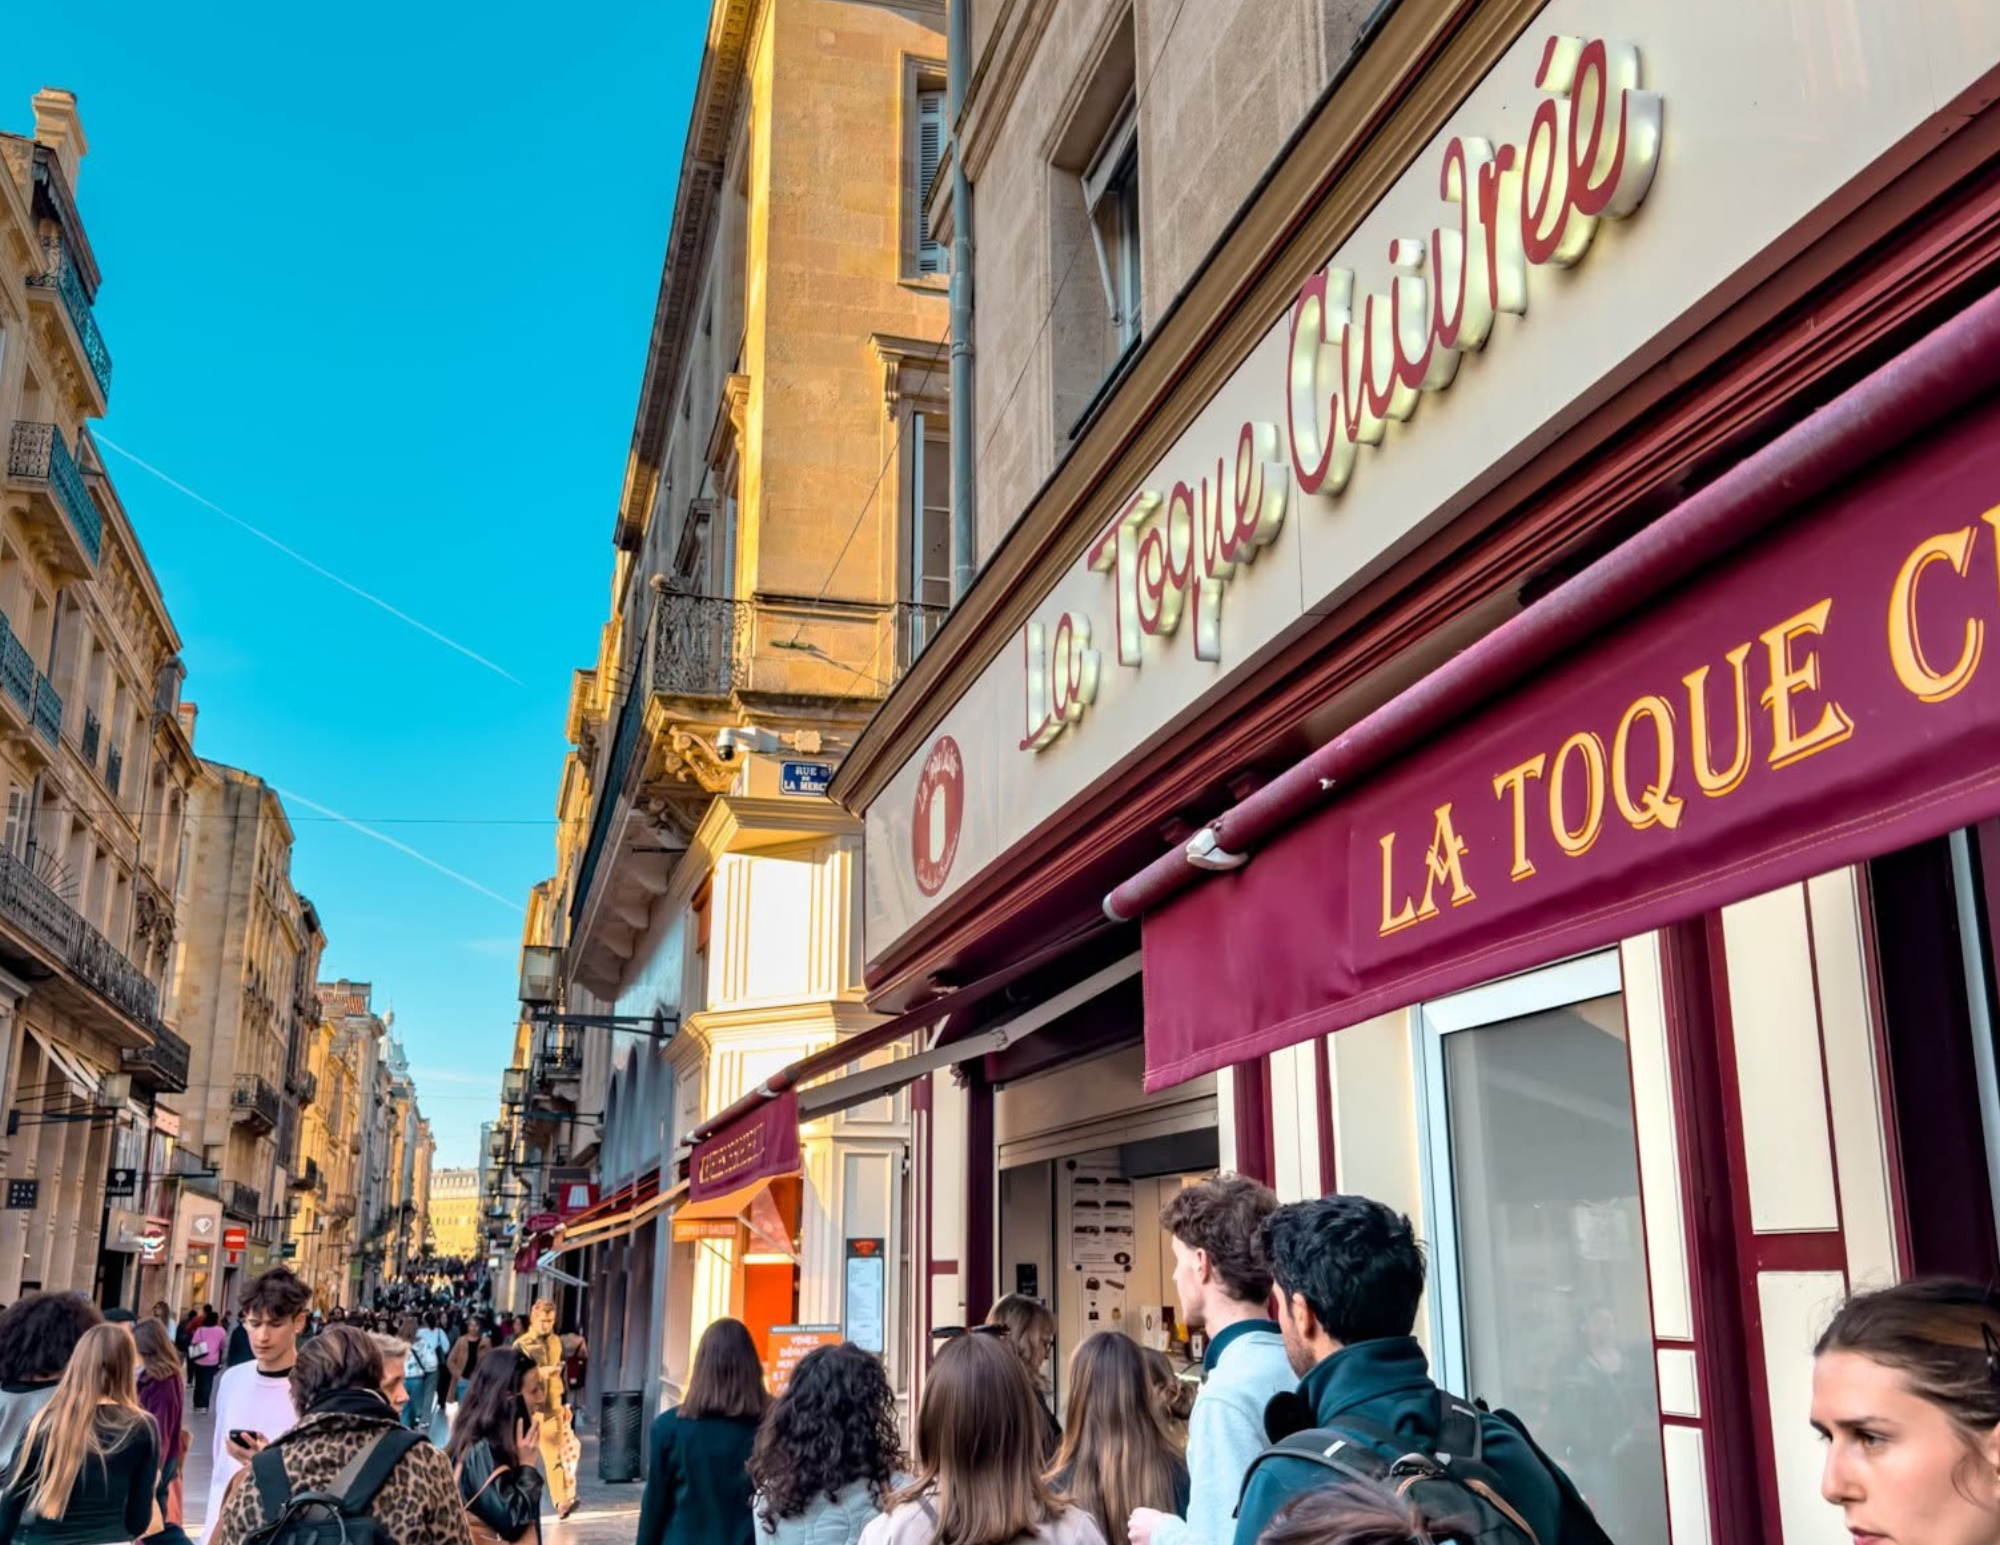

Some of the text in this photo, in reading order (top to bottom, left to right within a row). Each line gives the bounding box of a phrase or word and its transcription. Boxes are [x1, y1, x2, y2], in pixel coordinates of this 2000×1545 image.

[1019, 34, 1661, 752] La Toque Cuivrée
[784, 780, 827, 792] LA MERC
[795, 765, 817, 776] RUE
[1379, 802, 1477, 937] LA
[1492, 597, 1856, 883] TOQUE
